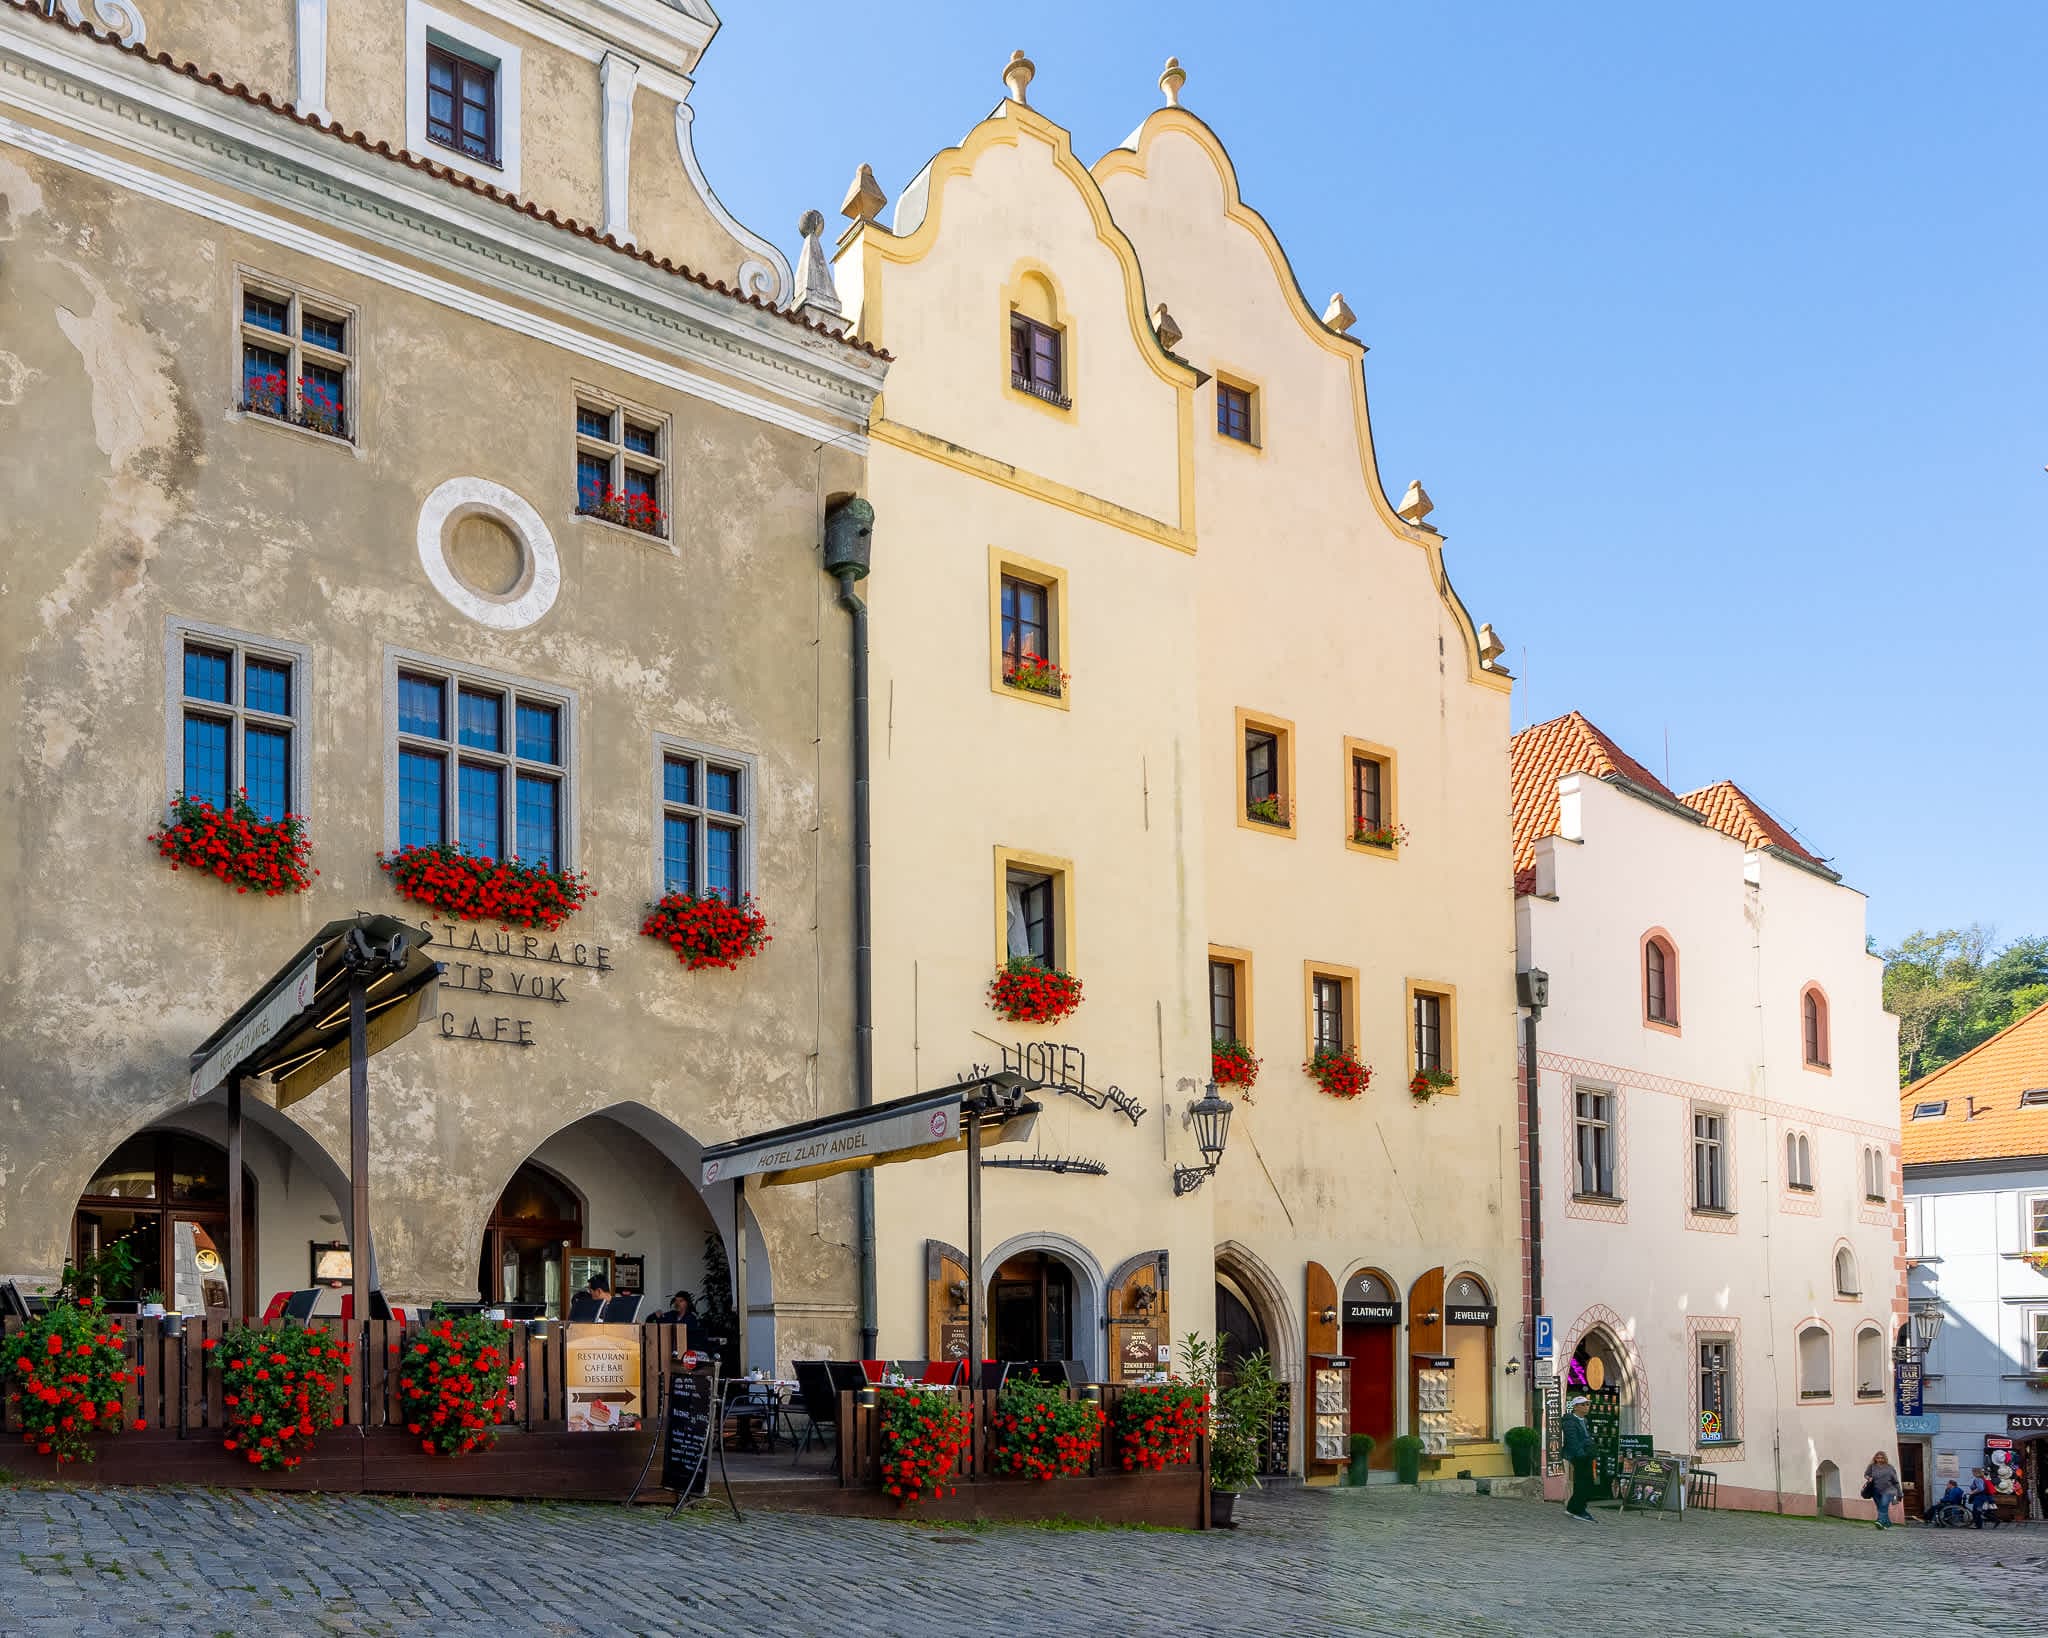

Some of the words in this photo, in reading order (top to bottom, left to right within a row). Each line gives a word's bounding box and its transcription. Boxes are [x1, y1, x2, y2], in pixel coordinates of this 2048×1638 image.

[357, 910, 613, 970] STAURACE
[511, 972, 567, 1001] VOK
[440, 1012, 534, 1045] CAFE
[1001, 1041, 1097, 1101] HOTEL
[757, 1151, 793, 1168] HOTEL
[1351, 1305, 1393, 1318] ZLATNICTVÍ
[1454, 1311, 1490, 1320] JEWELLERY
[1540, 1321, 1550, 1345] P
[584, 1375, 624, 1383] DESSERTS
[607, 1364, 623, 1372] BAR
[1899, 1379, 1912, 1415] cocktails
